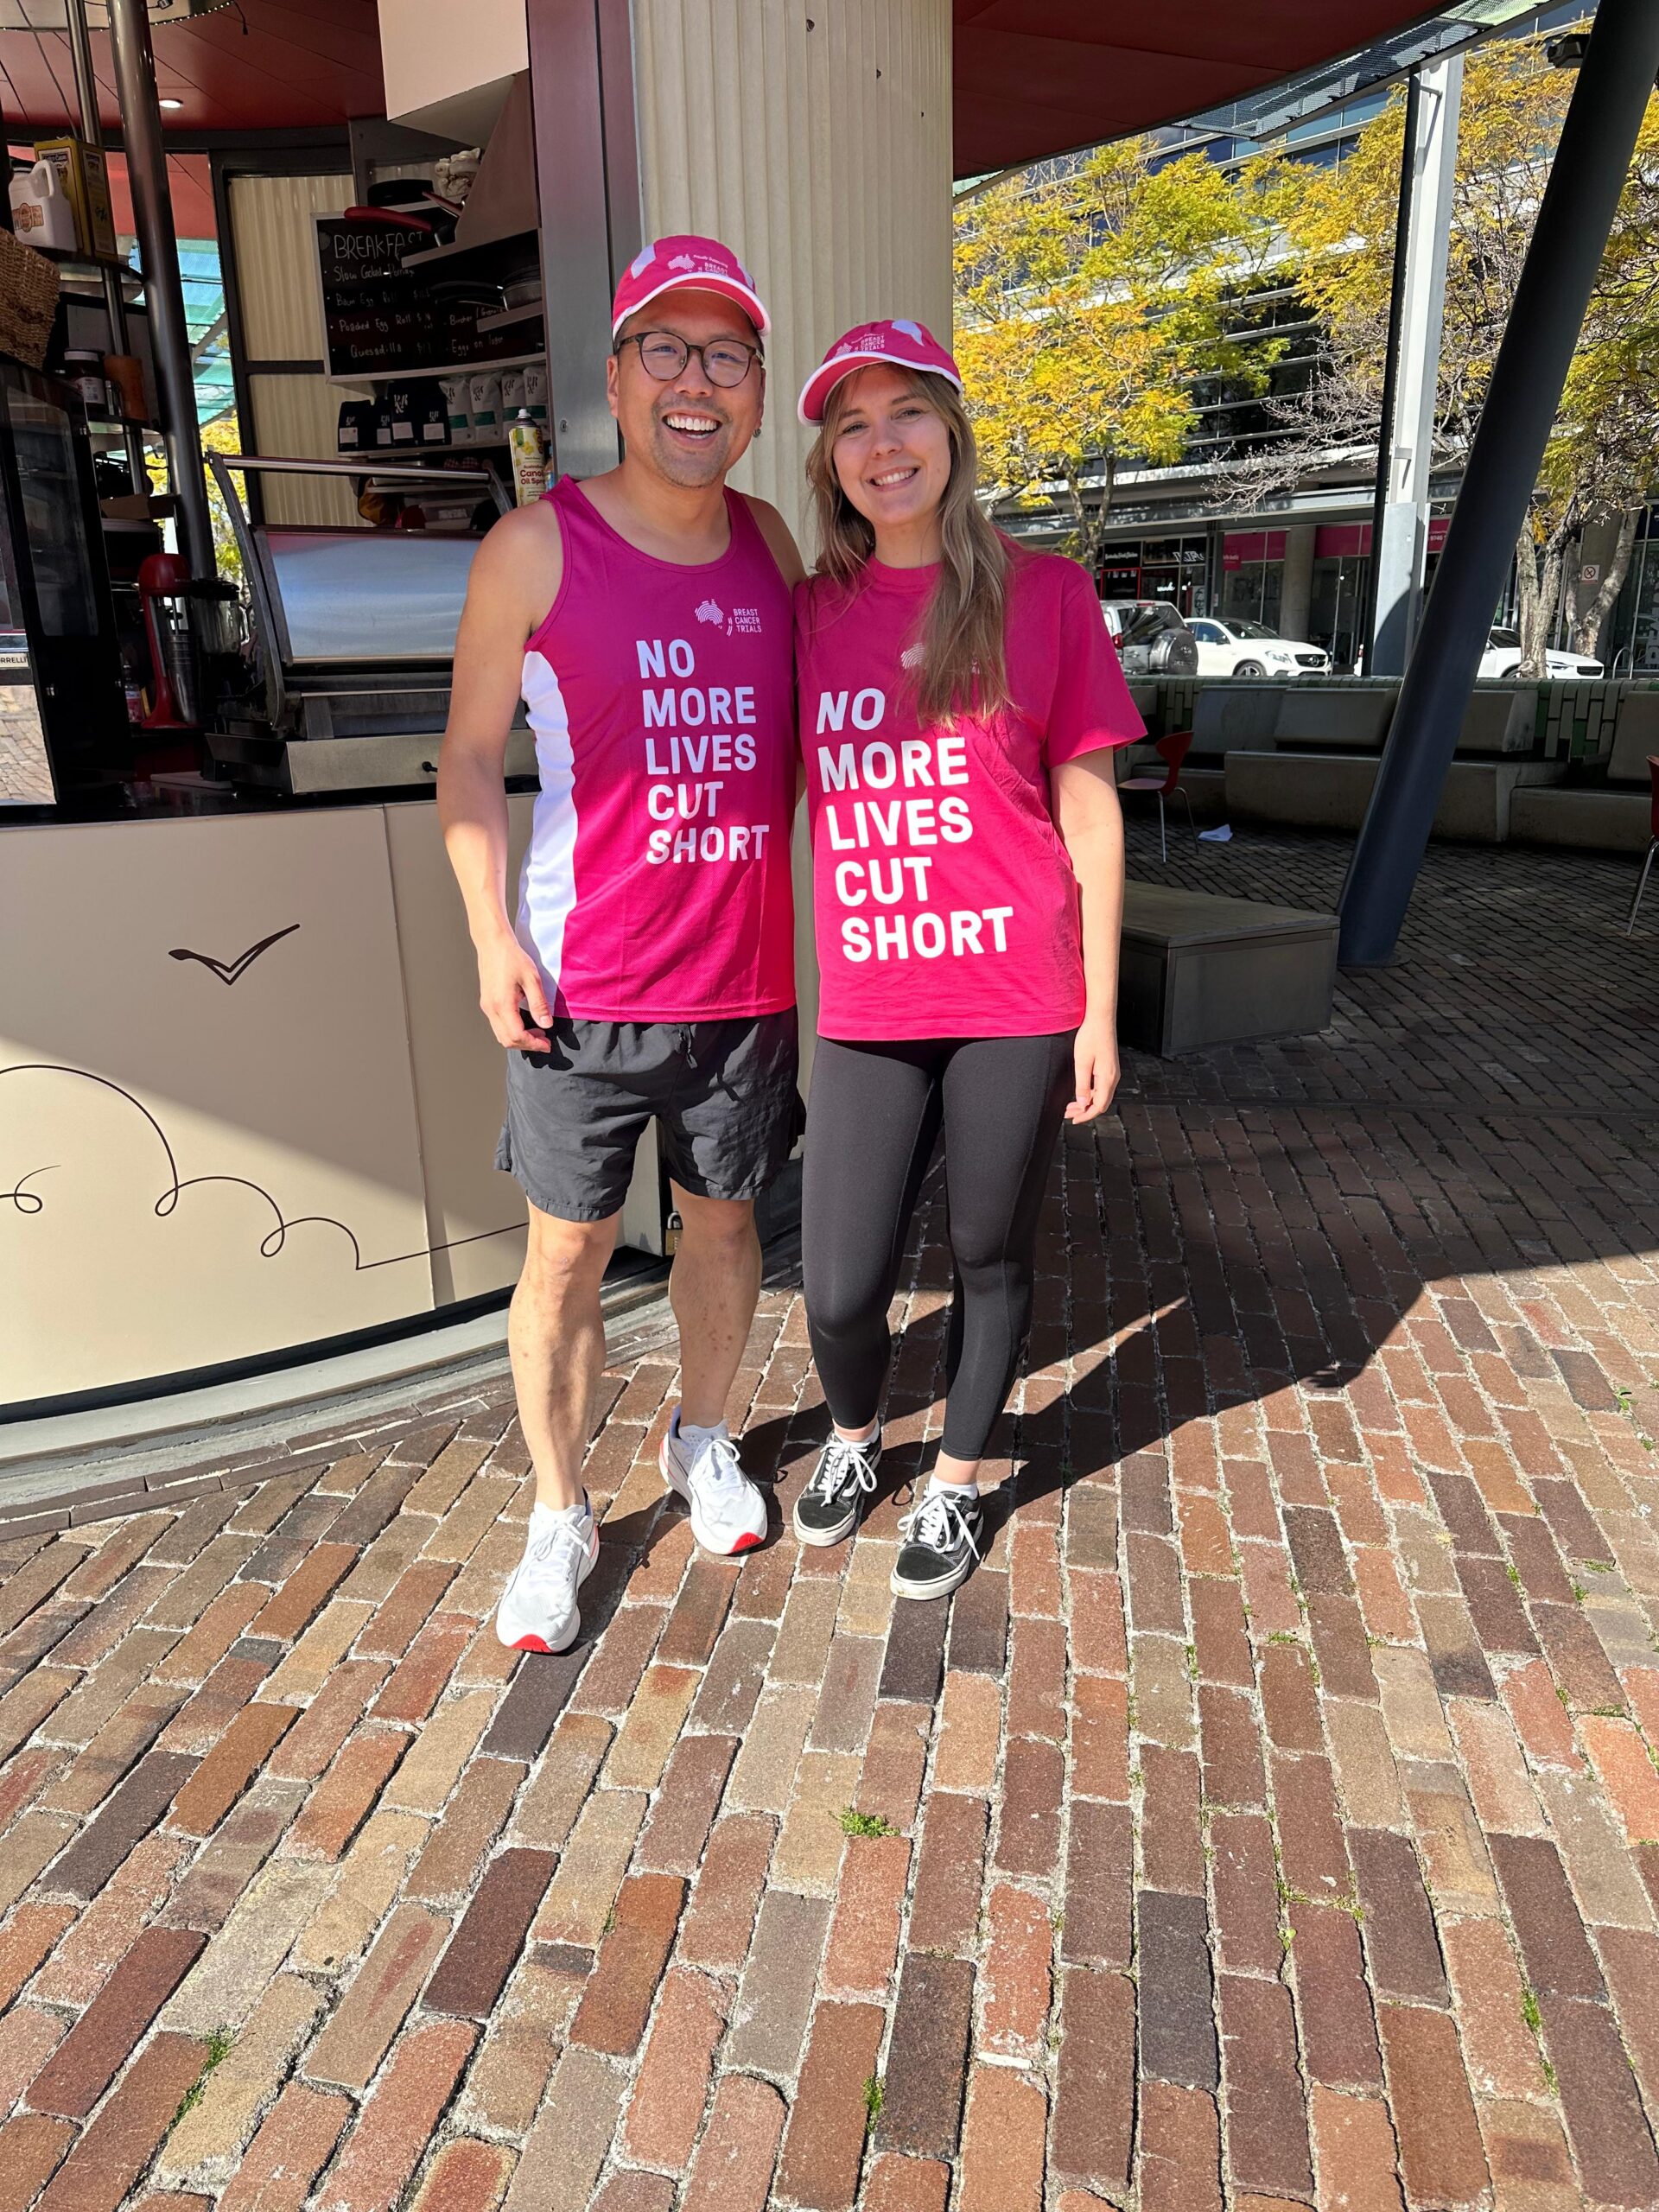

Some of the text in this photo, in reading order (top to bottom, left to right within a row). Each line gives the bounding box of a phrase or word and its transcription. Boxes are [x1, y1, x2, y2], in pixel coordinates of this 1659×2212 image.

[520, 469, 544, 478] Canol
[734, 616, 760, 625] CANCER
[636, 639, 694, 678] NO
[643, 687, 756, 727] MORE
[817, 689, 885, 734] NO
[646, 734, 756, 774] LIVES
[818, 737, 969, 792] MORE
[648, 782, 723, 820] CUT
[826, 797, 973, 850] LIVES
[645, 825, 769, 864] SHORT
[836, 857, 932, 906] CUT
[842, 906, 1014, 963] SHORT
